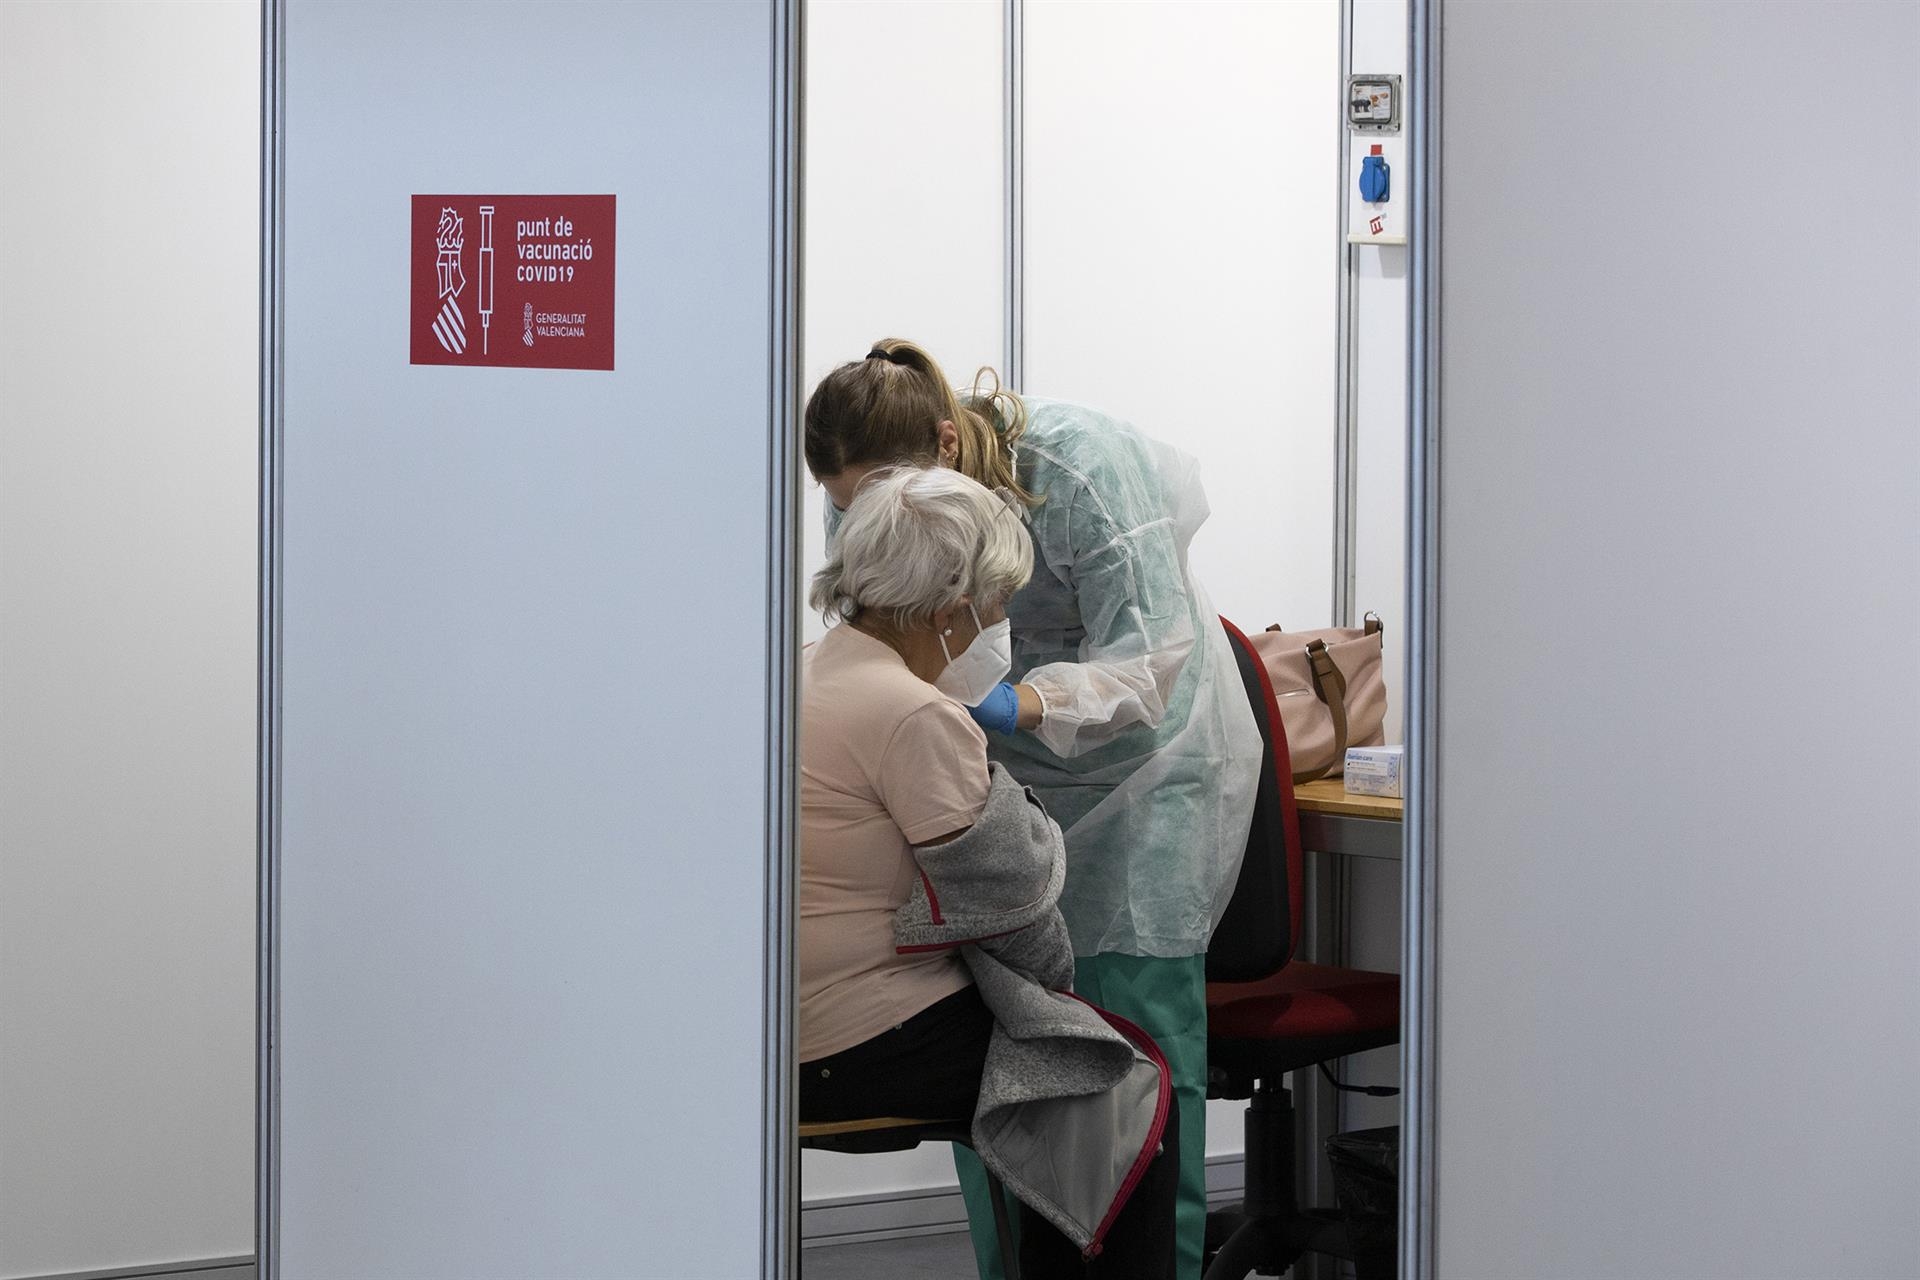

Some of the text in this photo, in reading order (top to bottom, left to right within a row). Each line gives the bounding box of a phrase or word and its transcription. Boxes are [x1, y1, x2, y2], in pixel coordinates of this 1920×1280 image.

[517, 216, 573, 241] punt de
[517, 239, 593, 260] vacunació
[517, 265, 574, 282] COVID19
[536, 313, 586, 324] GENERALITAT
[537, 326, 585, 337] VALENCIANA
